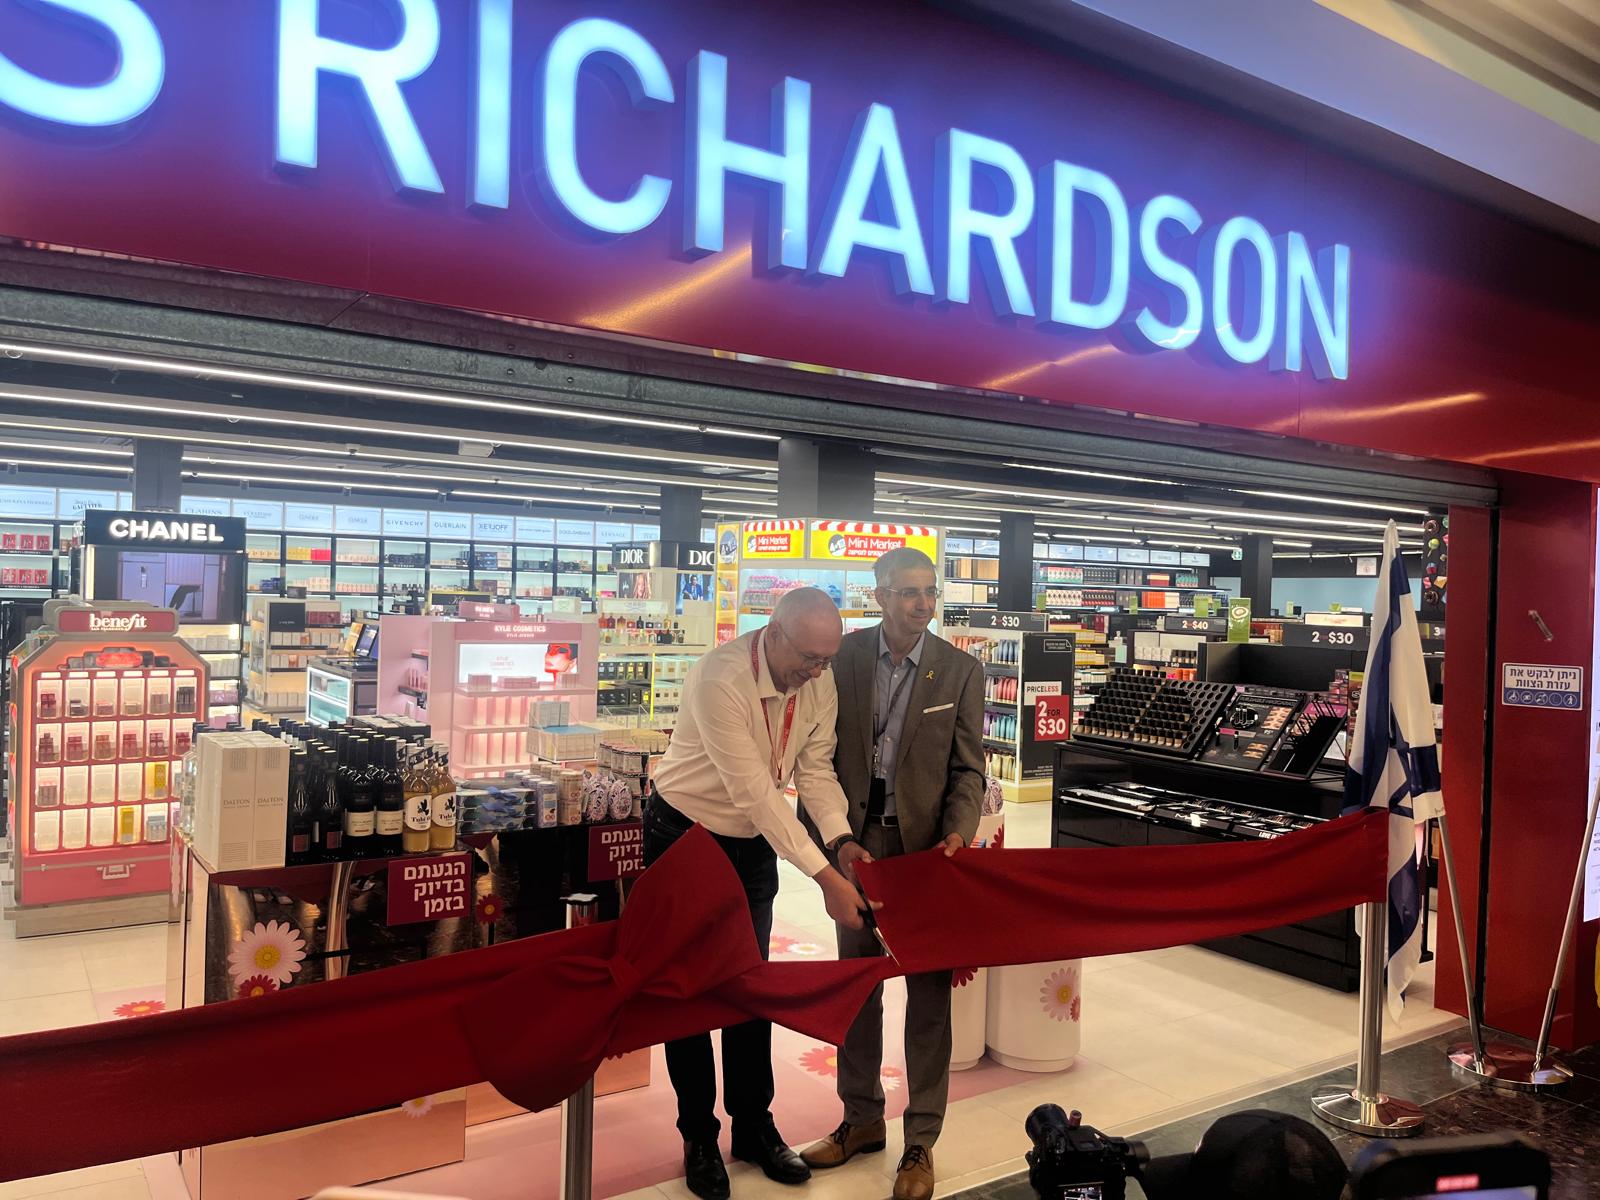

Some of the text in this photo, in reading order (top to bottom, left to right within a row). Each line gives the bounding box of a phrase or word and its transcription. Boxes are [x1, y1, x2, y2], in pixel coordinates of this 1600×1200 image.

[276, 0, 1350, 380] RICHARDSON
[110, 518, 224, 543] CHANEL
[386, 519, 424, 527] GIVENCHY
[434, 521, 467, 529] GUERLAIN
[848, 537, 868, 549] Mini
[869, 538, 902, 550] Market
[620, 549, 644, 564] DIOR
[89, 613, 147, 631] benefit
[990, 615, 997, 626] 2
[1002, 616, 1020, 627] $30
[1182, 620, 1188, 629] 2
[1192, 620, 1209, 630] $40
[1311, 631, 1320, 642] 2
[1328, 631, 1354, 644] $30
[1509, 668, 1577, 681] ניתן לבקש את
[1026, 685, 1059, 693] PRICELESS
[1515, 679, 1571, 690] עזרת הצוות
[1038, 701, 1048, 717] 2
[1037, 718, 1066, 736] $30
[601, 829, 643, 844] געתם
[609, 843, 643, 862] דיוק
[404, 861, 466, 881] הגעתם
[617, 858, 646, 876] זמן
[414, 878, 465, 902] בדיוק
[423, 895, 465, 918] בזמן
